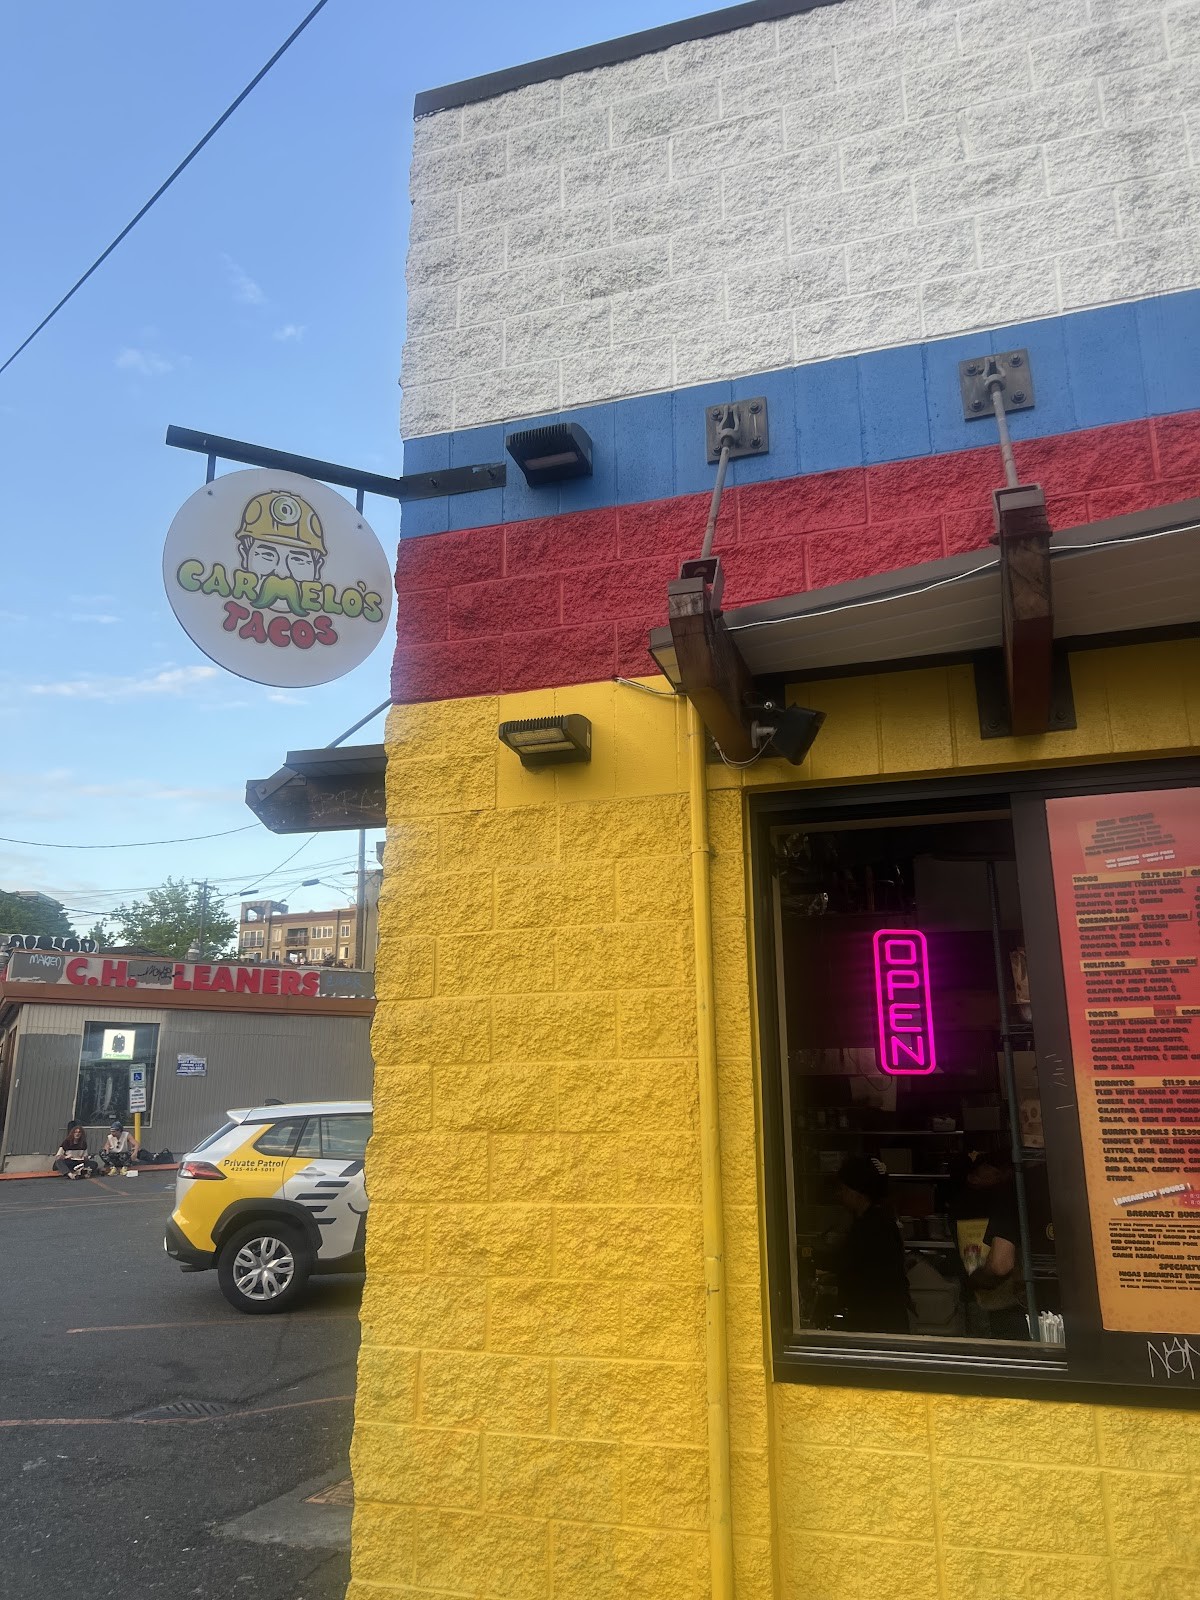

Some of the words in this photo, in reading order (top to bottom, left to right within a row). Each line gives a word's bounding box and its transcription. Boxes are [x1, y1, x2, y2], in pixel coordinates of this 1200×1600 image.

[177, 558, 383, 622] CARMELO'S
[223, 600, 338, 649] TACOS
[1079, 916, 1130, 924] QUESADILLAS
[885, 940, 925, 1066] OPEN
[224, 1159, 255, 1167] Private
[257, 1159, 284, 1167] Patrol
[1127, 1210, 1174, 1218] BREAKFAST
[1143, 1271, 1182, 1279] BREAKFAST
